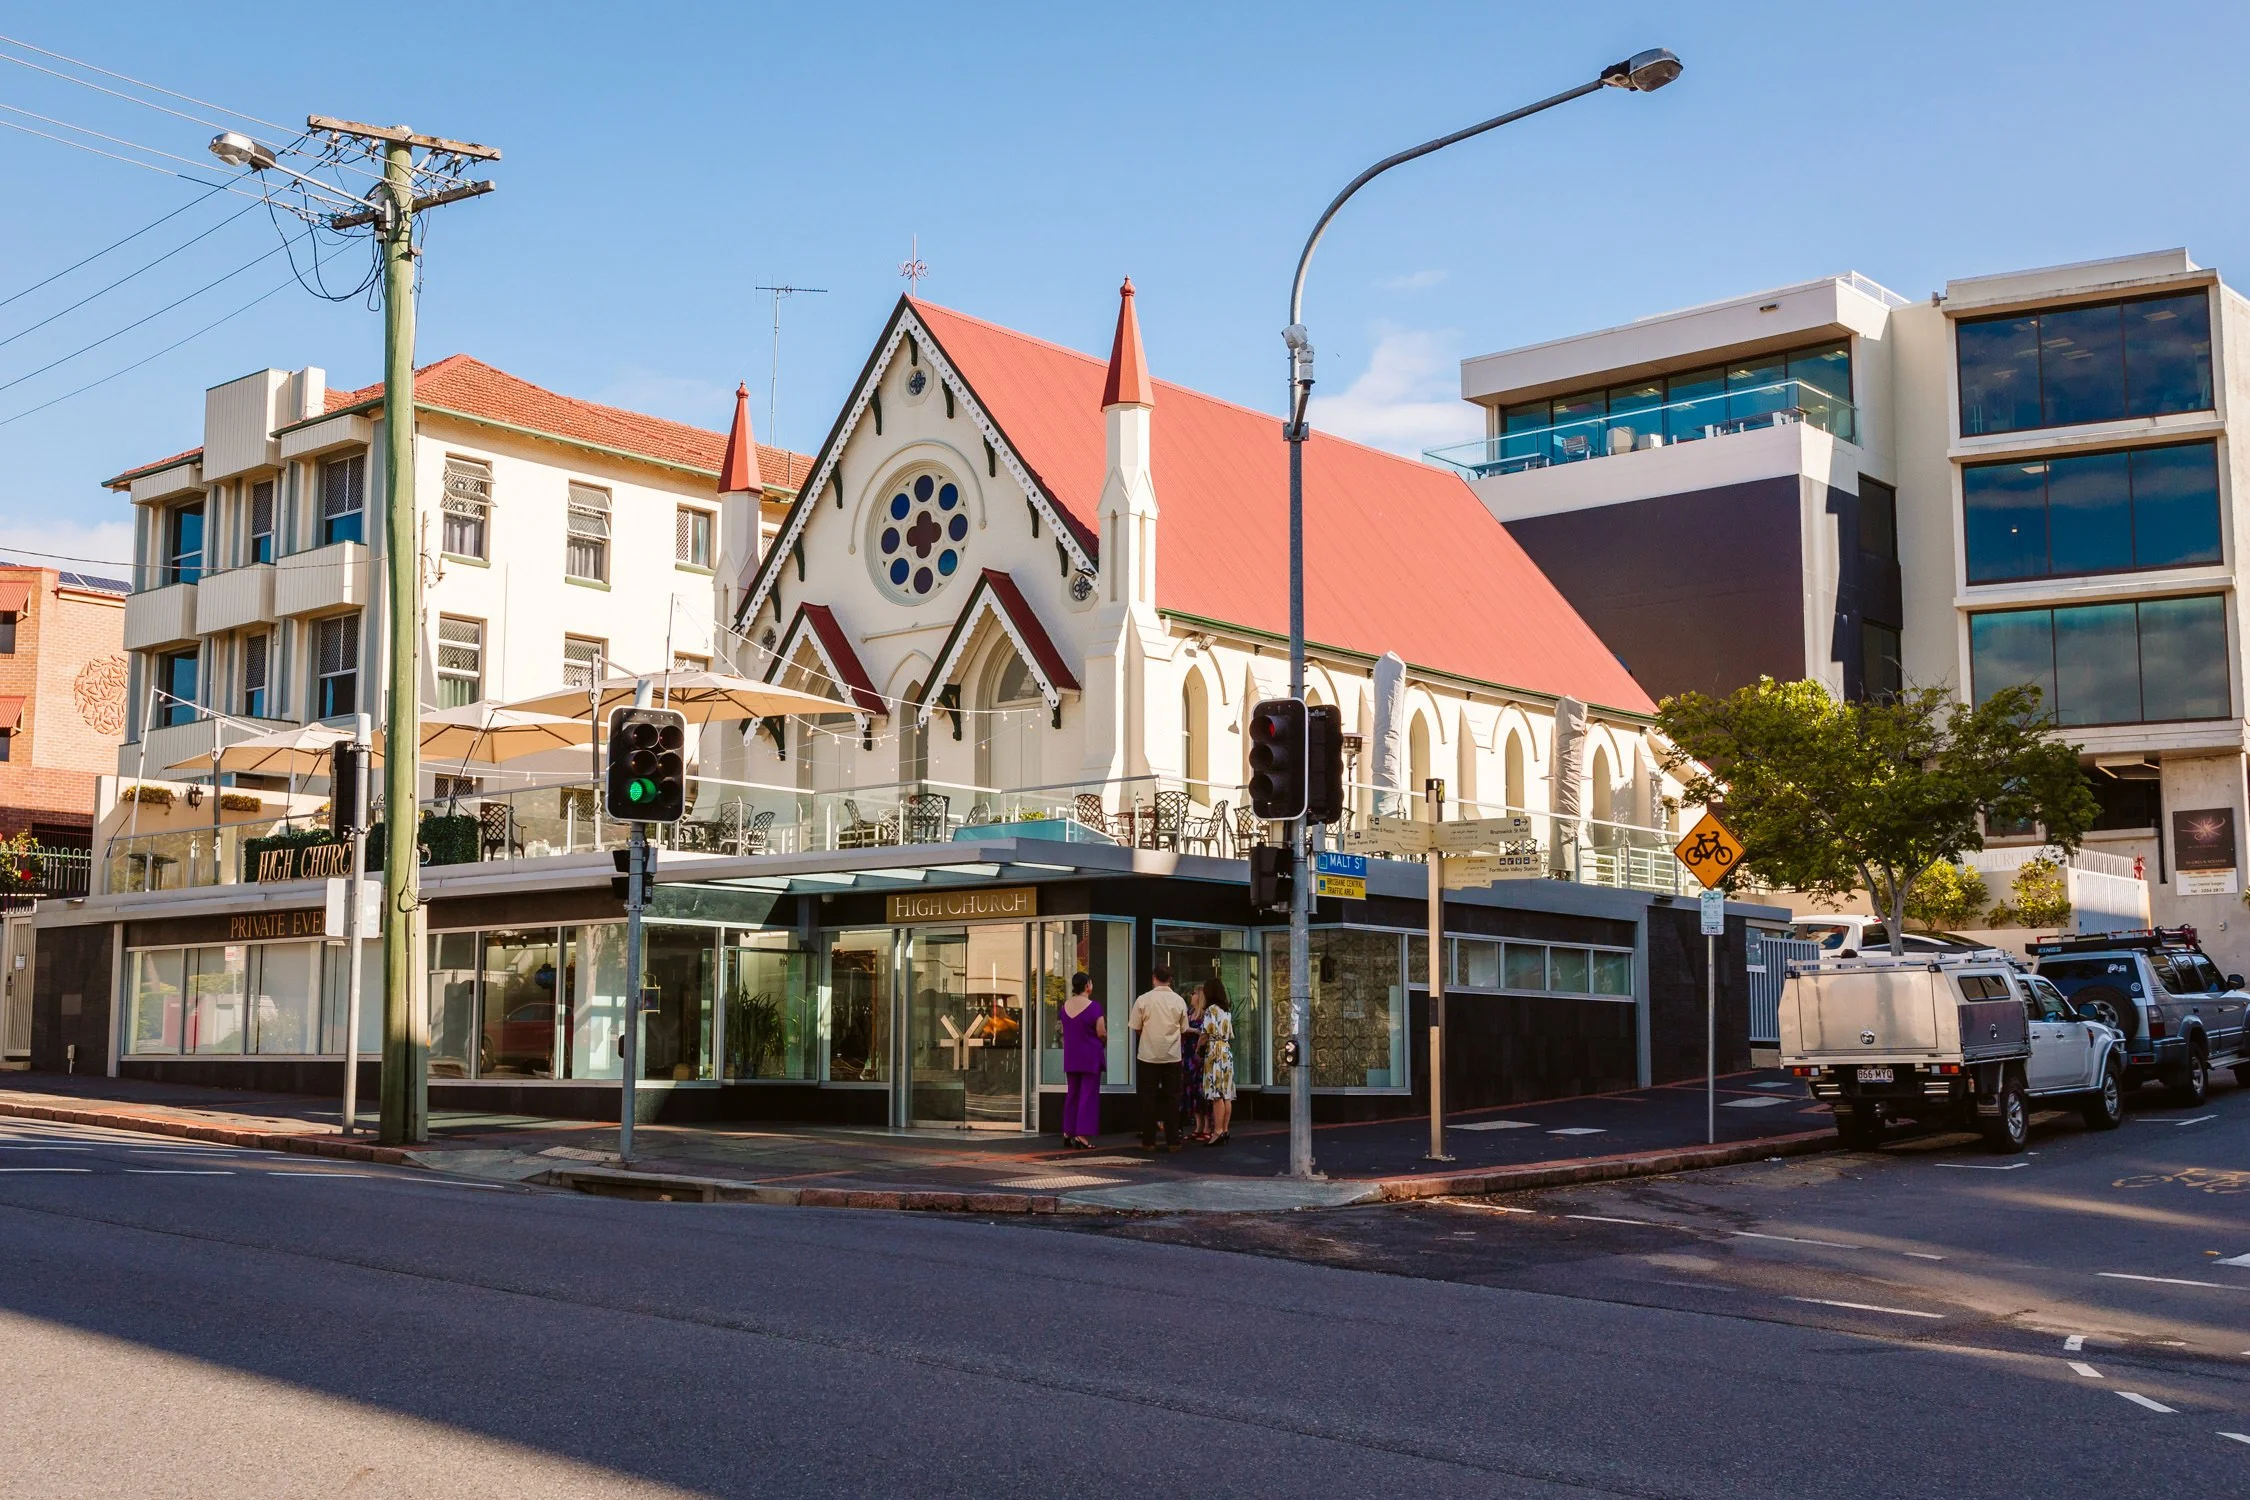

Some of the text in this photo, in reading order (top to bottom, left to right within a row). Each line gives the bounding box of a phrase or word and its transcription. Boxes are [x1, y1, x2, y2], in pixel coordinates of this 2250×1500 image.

[258, 848, 295, 881] HIGH
[1330, 854, 1363, 870] MALT ST
[1326, 877, 1364, 889] BRISBANE CENTRAL
[1327, 886, 1355, 896] TRAFFIC AREA
[895, 893, 1028, 917] HIGH CHURCH
[230, 913, 286, 939] PRIVATE
[2038, 946, 2062, 954] KINGS
